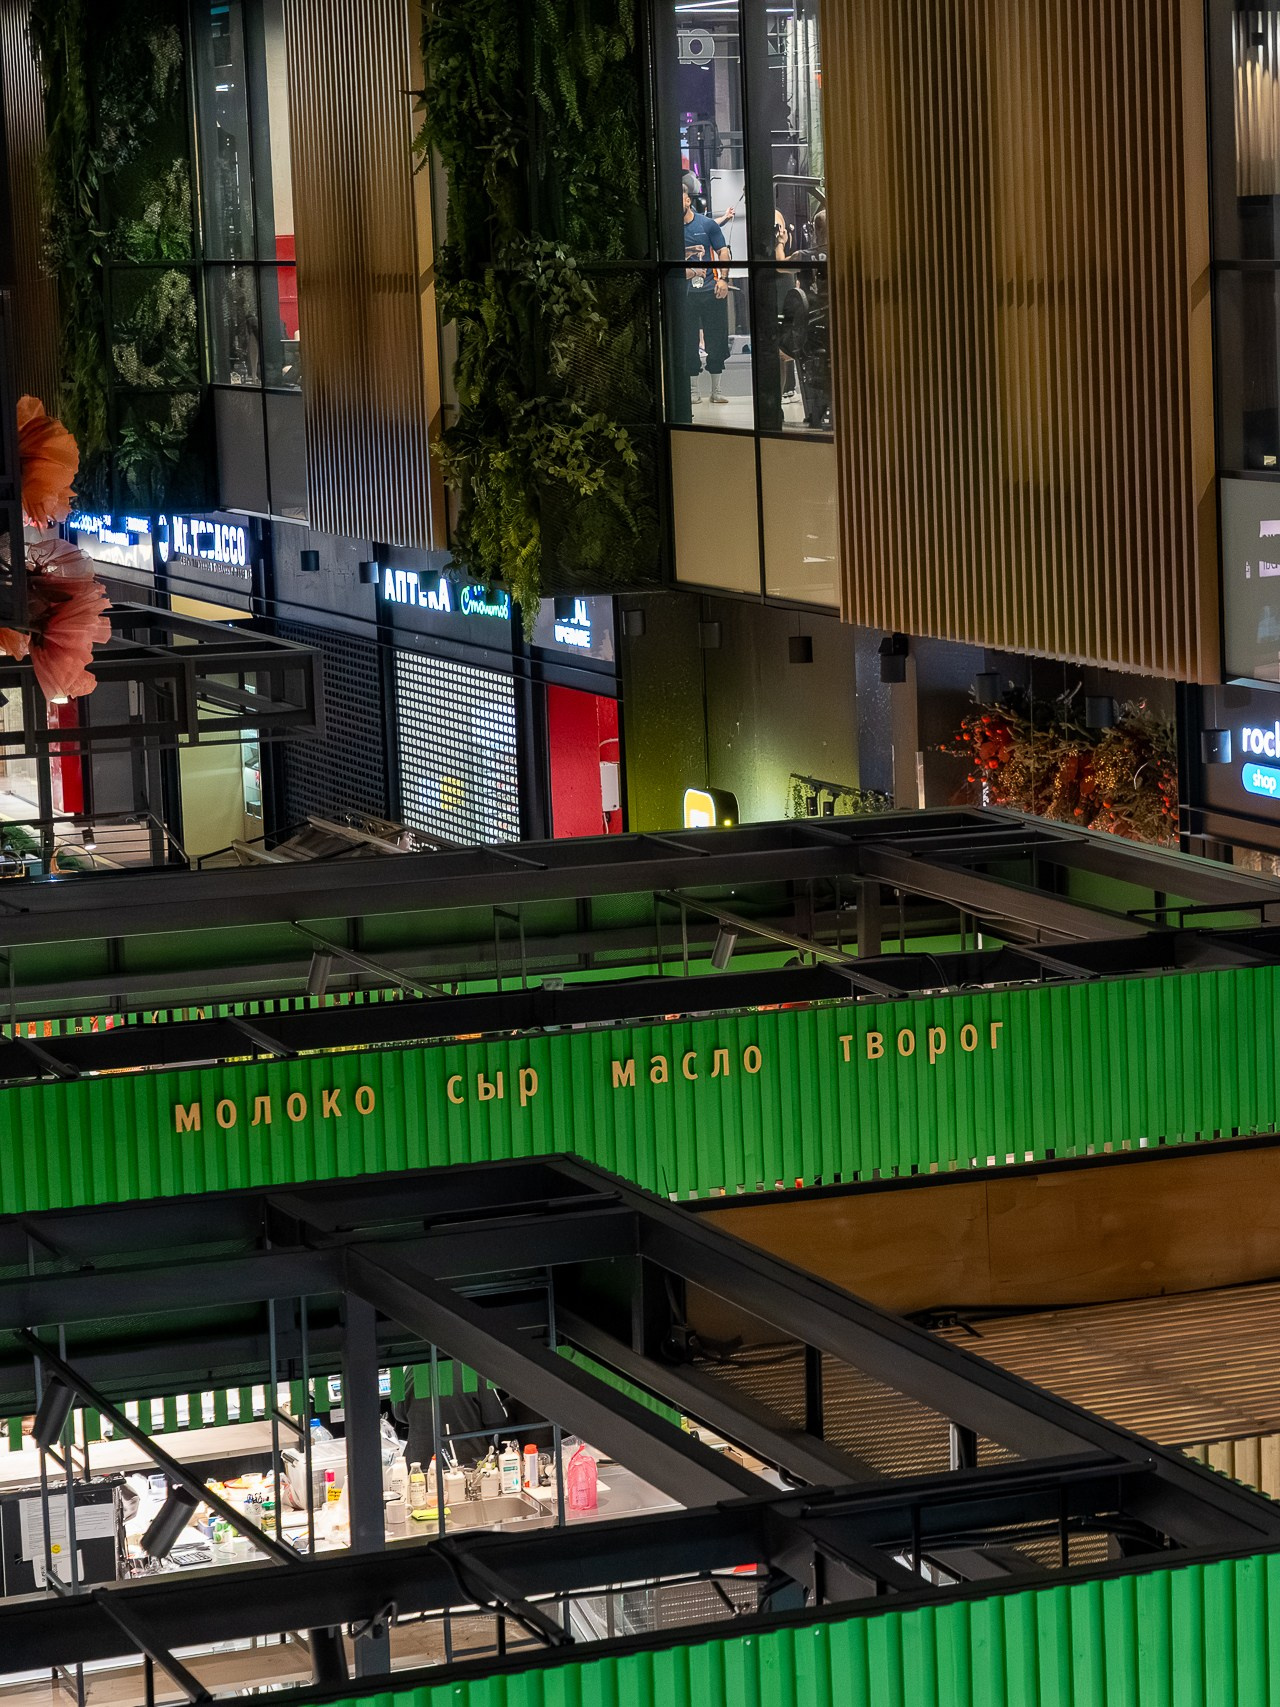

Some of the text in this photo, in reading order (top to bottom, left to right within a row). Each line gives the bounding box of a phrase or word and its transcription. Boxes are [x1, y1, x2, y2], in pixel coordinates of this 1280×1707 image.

[1252, 769, 1277, 794] shop
[174, 1021, 1004, 1133] молоко сыр масло творог
